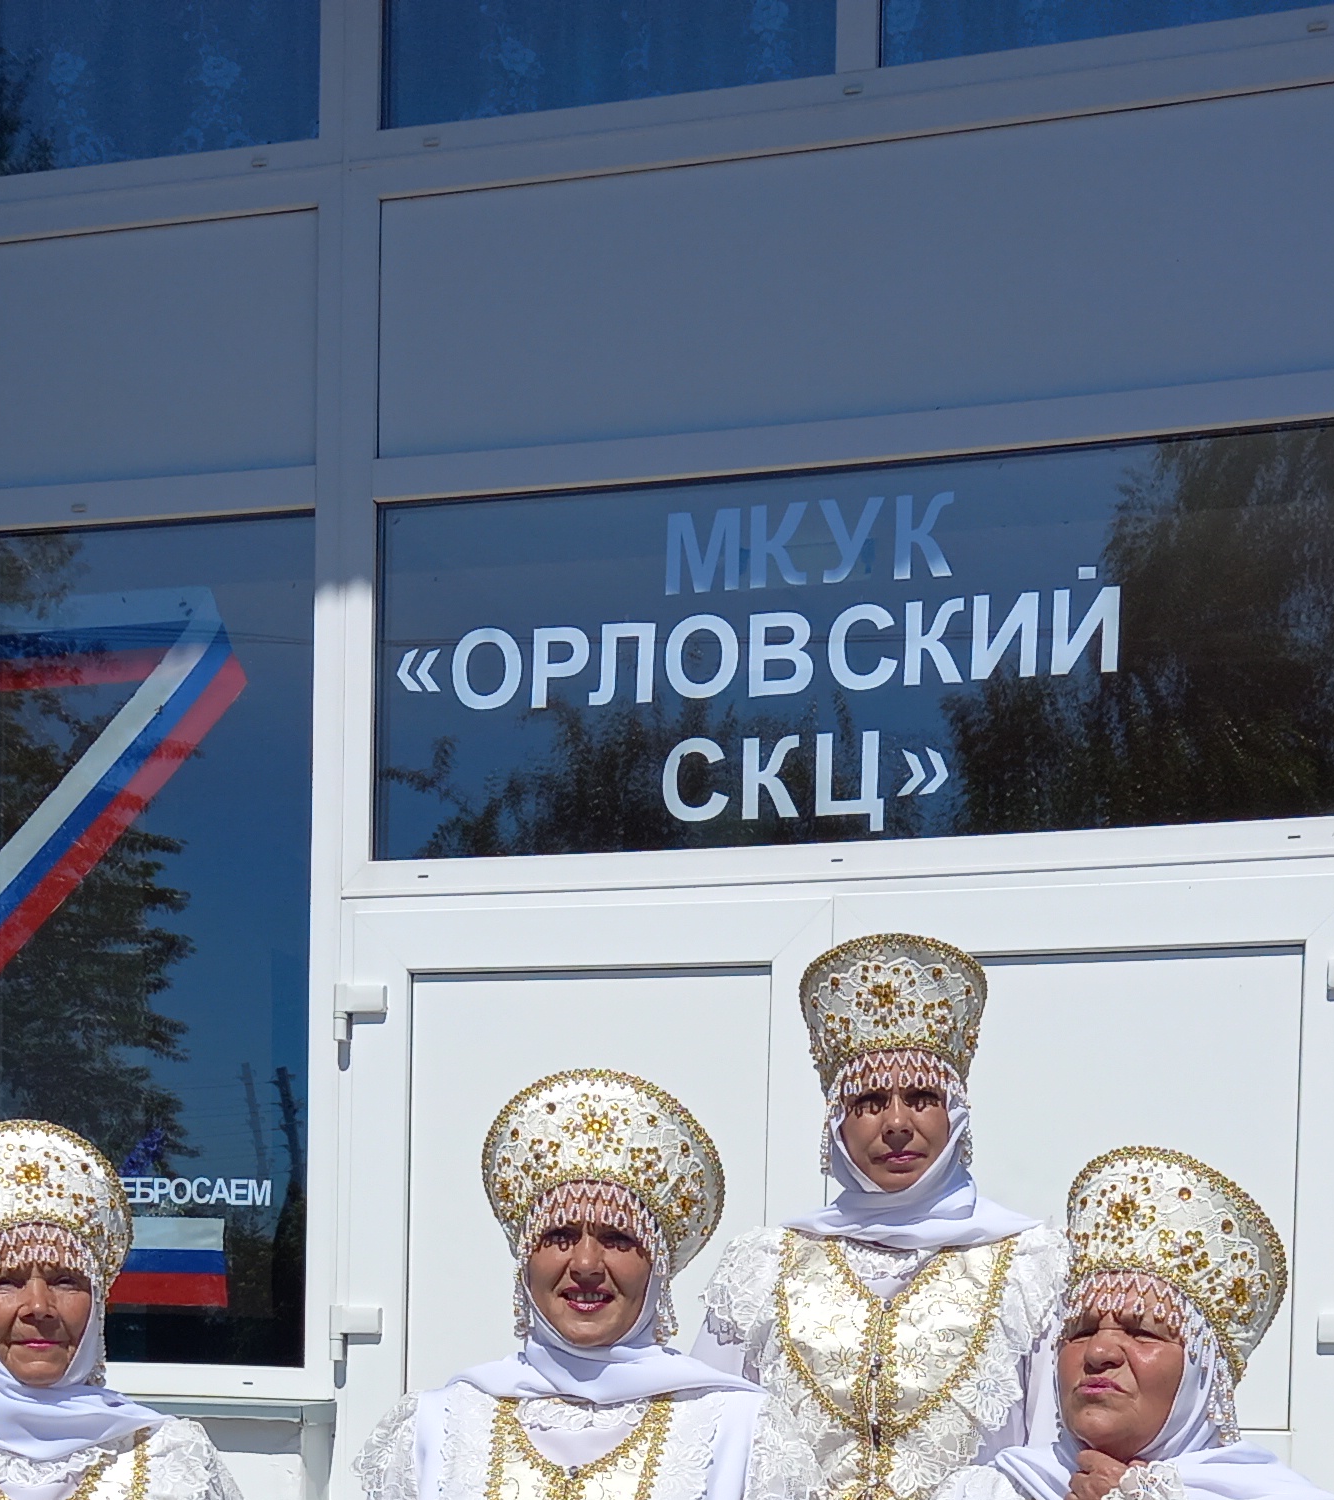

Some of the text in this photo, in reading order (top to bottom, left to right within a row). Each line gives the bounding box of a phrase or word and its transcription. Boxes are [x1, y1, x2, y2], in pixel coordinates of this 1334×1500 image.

[665, 490, 956, 596] МКУК
[397, 566, 1121, 710] «ОРЛОВСКИЙ
[663, 731, 949, 831] СКЦ»
